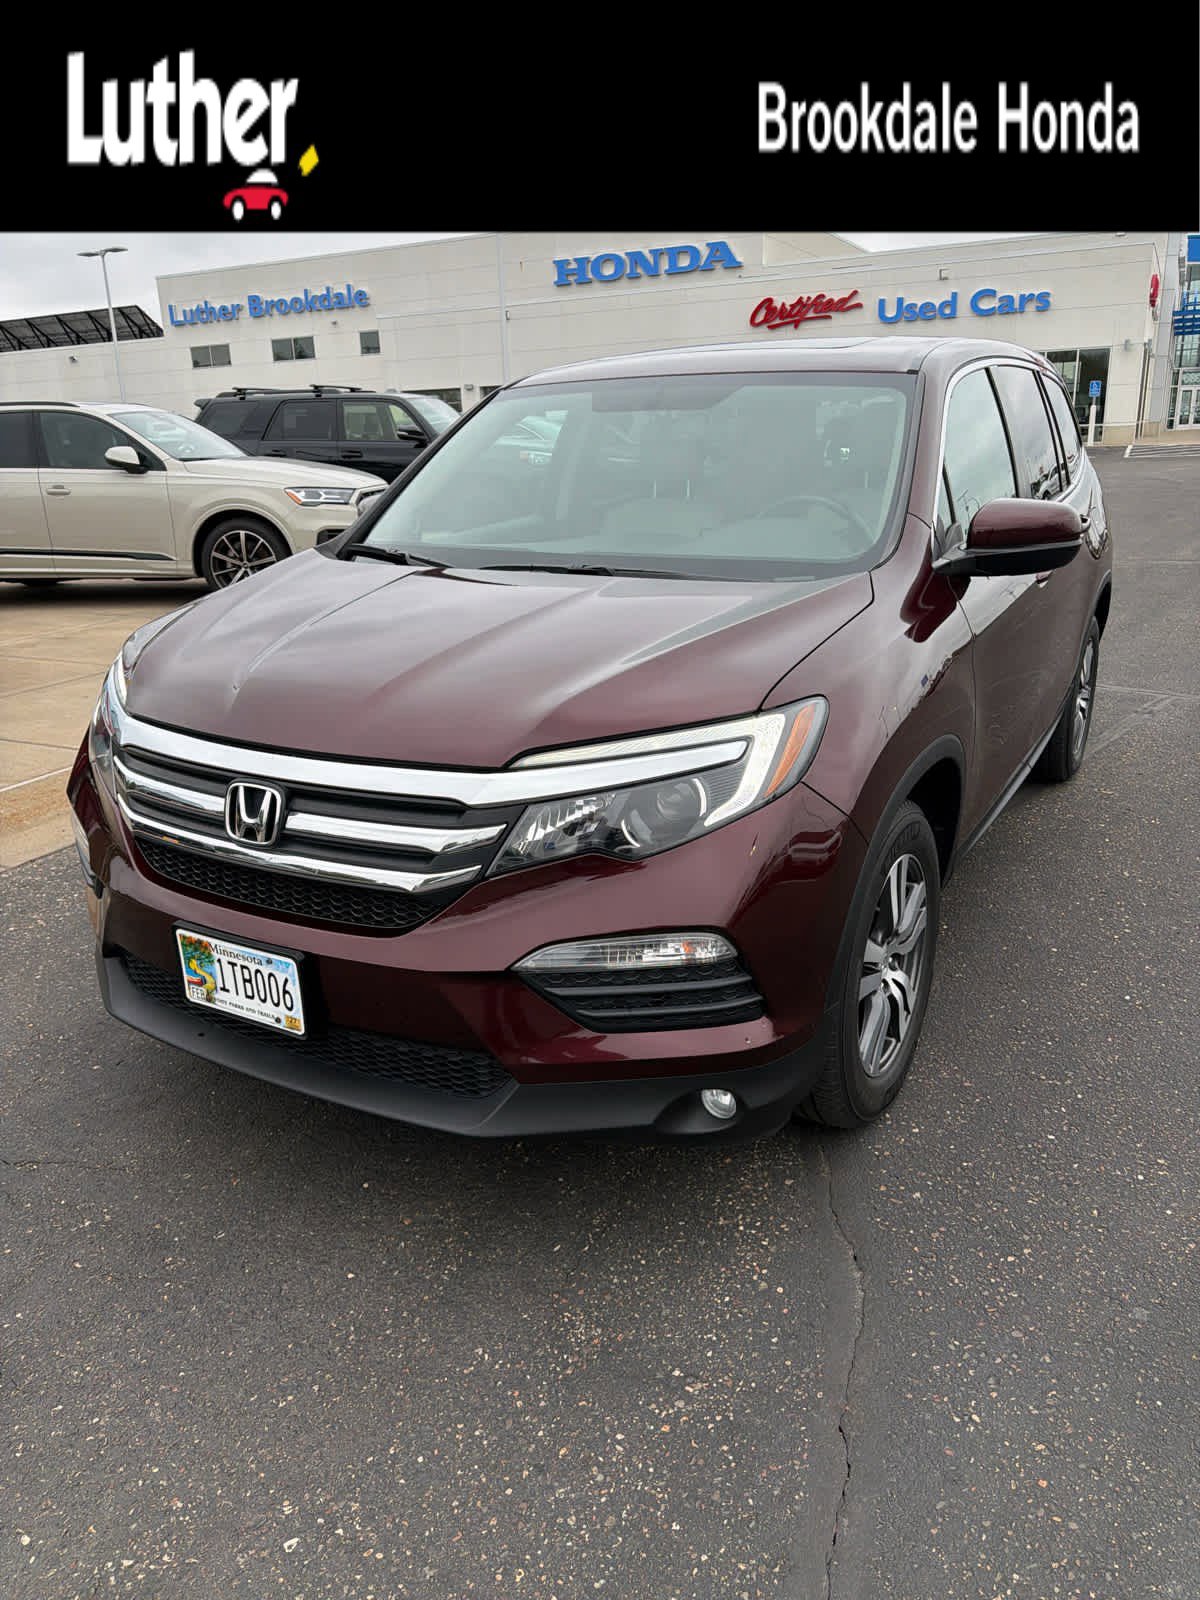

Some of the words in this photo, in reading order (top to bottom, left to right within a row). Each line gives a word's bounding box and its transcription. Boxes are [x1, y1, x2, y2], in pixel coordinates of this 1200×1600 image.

[553, 240, 744, 287] HONDA
[168, 300, 244, 327] Luther
[247, 284, 370, 318] Brookdale
[749, 289, 863, 330] Certified
[878, 291, 958, 324] Used
[969, 288, 1051, 317] Cars
[208, 942, 263, 966] Minnesota
[217, 958, 294, 1012] 1TB006
